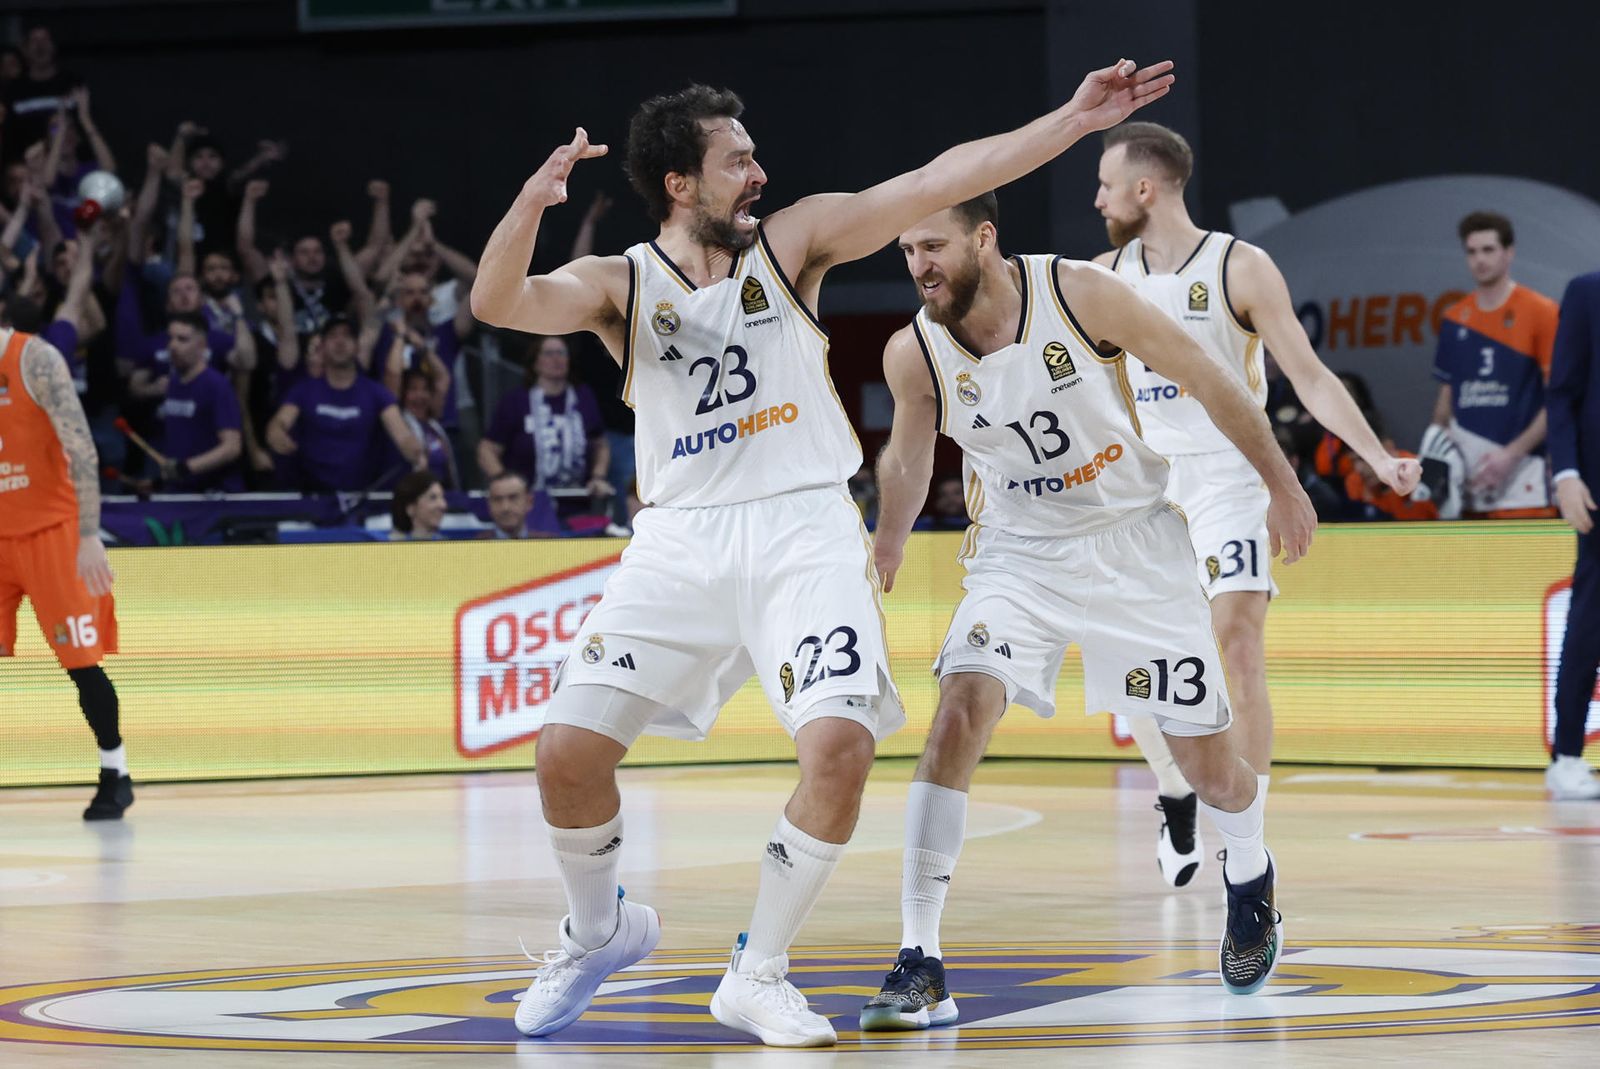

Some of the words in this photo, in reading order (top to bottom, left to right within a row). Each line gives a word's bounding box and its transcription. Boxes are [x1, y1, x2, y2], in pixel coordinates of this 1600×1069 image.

[744, 315, 780, 328] oneteam
[688, 344, 757, 416] 23
[1050, 376, 1083, 394] oneteam
[1478, 347, 1495, 376] 3
[671, 402, 799, 460] AUTOHERO
[1004, 411, 1071, 465] 13
[1220, 539, 1258, 579] 31
[66, 614, 99, 648] 16
[794, 625, 861, 694] 23
[1150, 656, 1207, 706] 13
[478, 661, 564, 722] Ma
